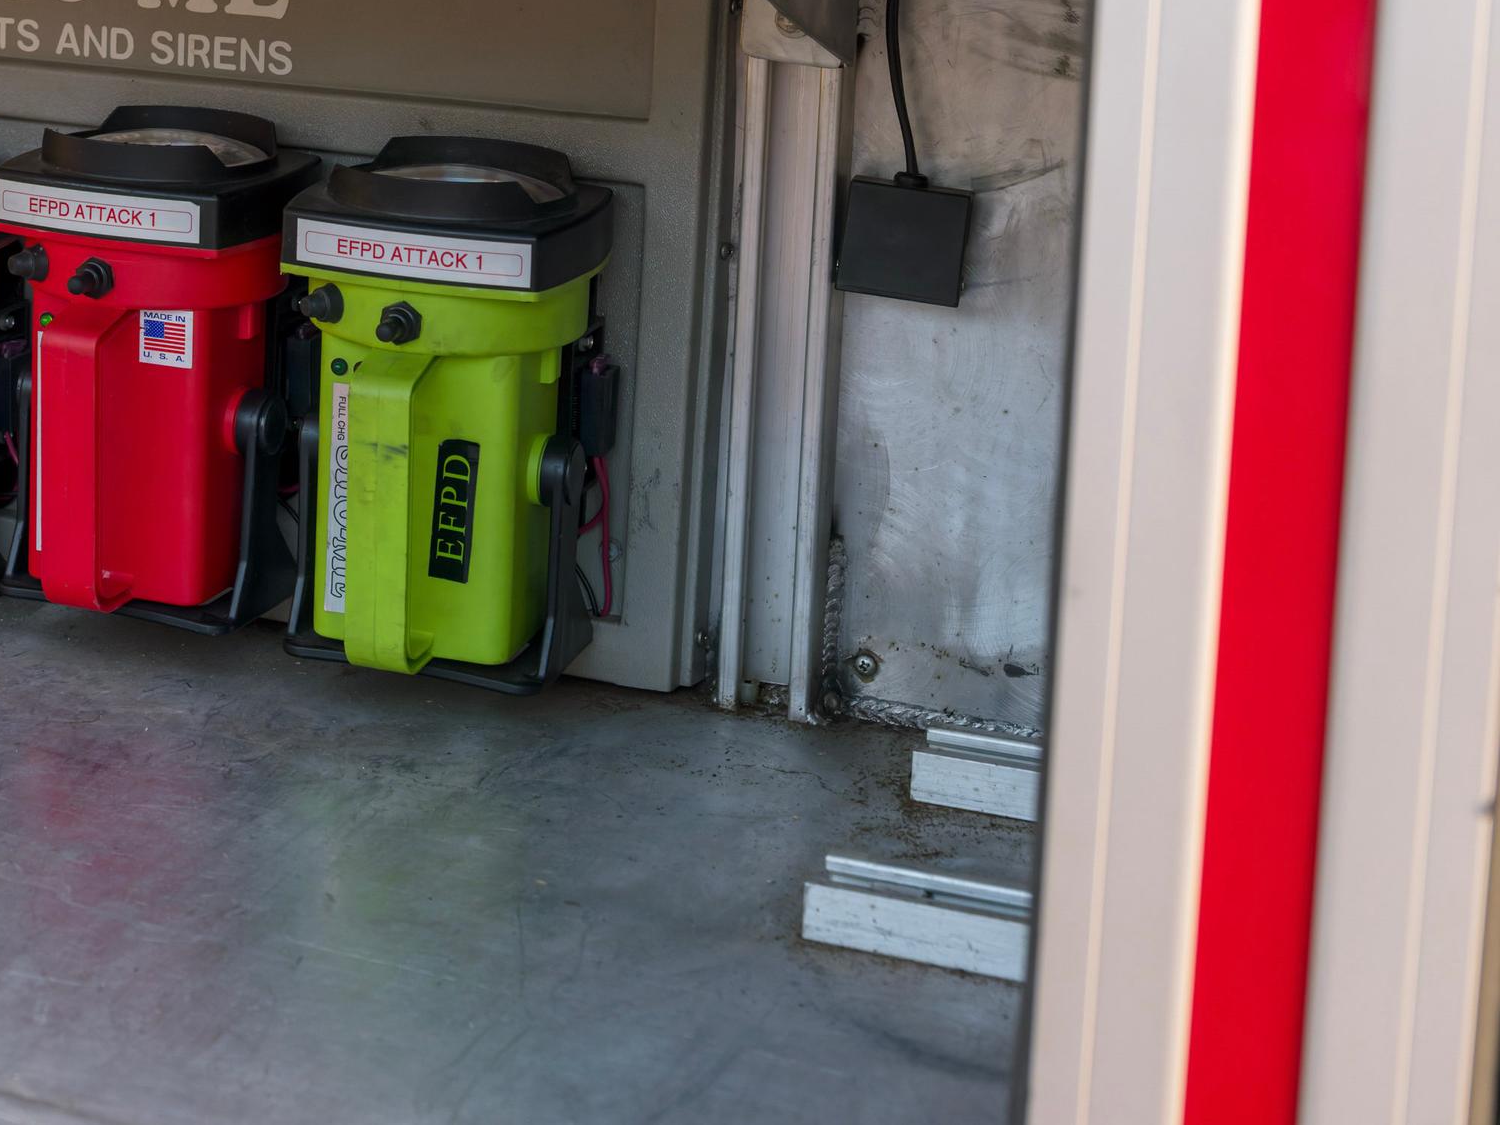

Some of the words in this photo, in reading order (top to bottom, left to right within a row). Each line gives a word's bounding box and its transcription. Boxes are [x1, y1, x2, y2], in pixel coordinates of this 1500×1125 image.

[55, 23, 135, 61] AND
[150, 31, 293, 76] SIRENS
[29, 197, 69, 217] EFPD
[74, 204, 142, 226] ATTACK
[149, 212, 156, 227] 1
[337, 238, 385, 259] EFPD
[391, 246, 468, 269] ATTACK
[476, 254, 482, 271] 1
[143, 311, 173, 322] MADE
[175, 314, 186, 323] IN
[338, 396, 347, 419] FULL
[337, 420, 346, 441] CHG
[436, 454, 472, 564] EFPD
